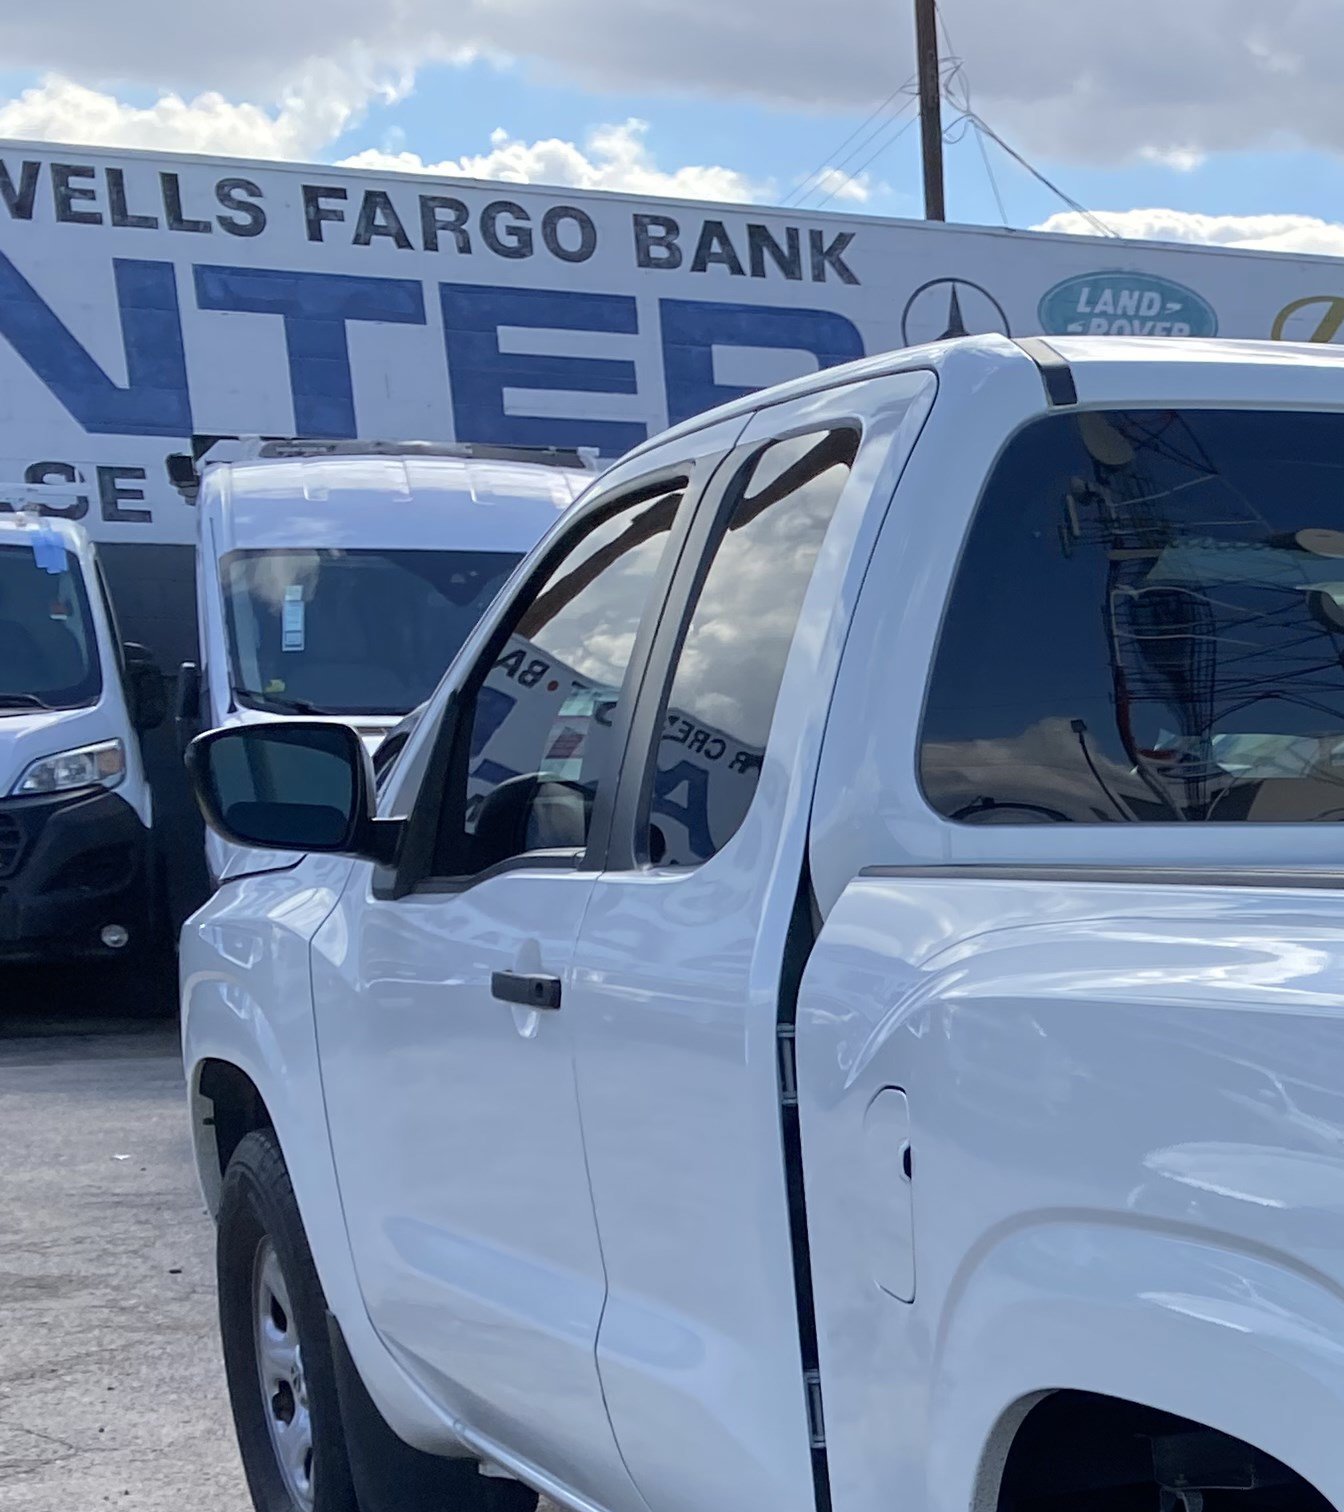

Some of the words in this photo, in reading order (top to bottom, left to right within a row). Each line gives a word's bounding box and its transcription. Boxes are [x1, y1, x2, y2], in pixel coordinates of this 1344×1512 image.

[301, 184, 598, 264] FARGO
[632, 213, 862, 286] BANK
[1076, 287, 1162, 317] LAND
